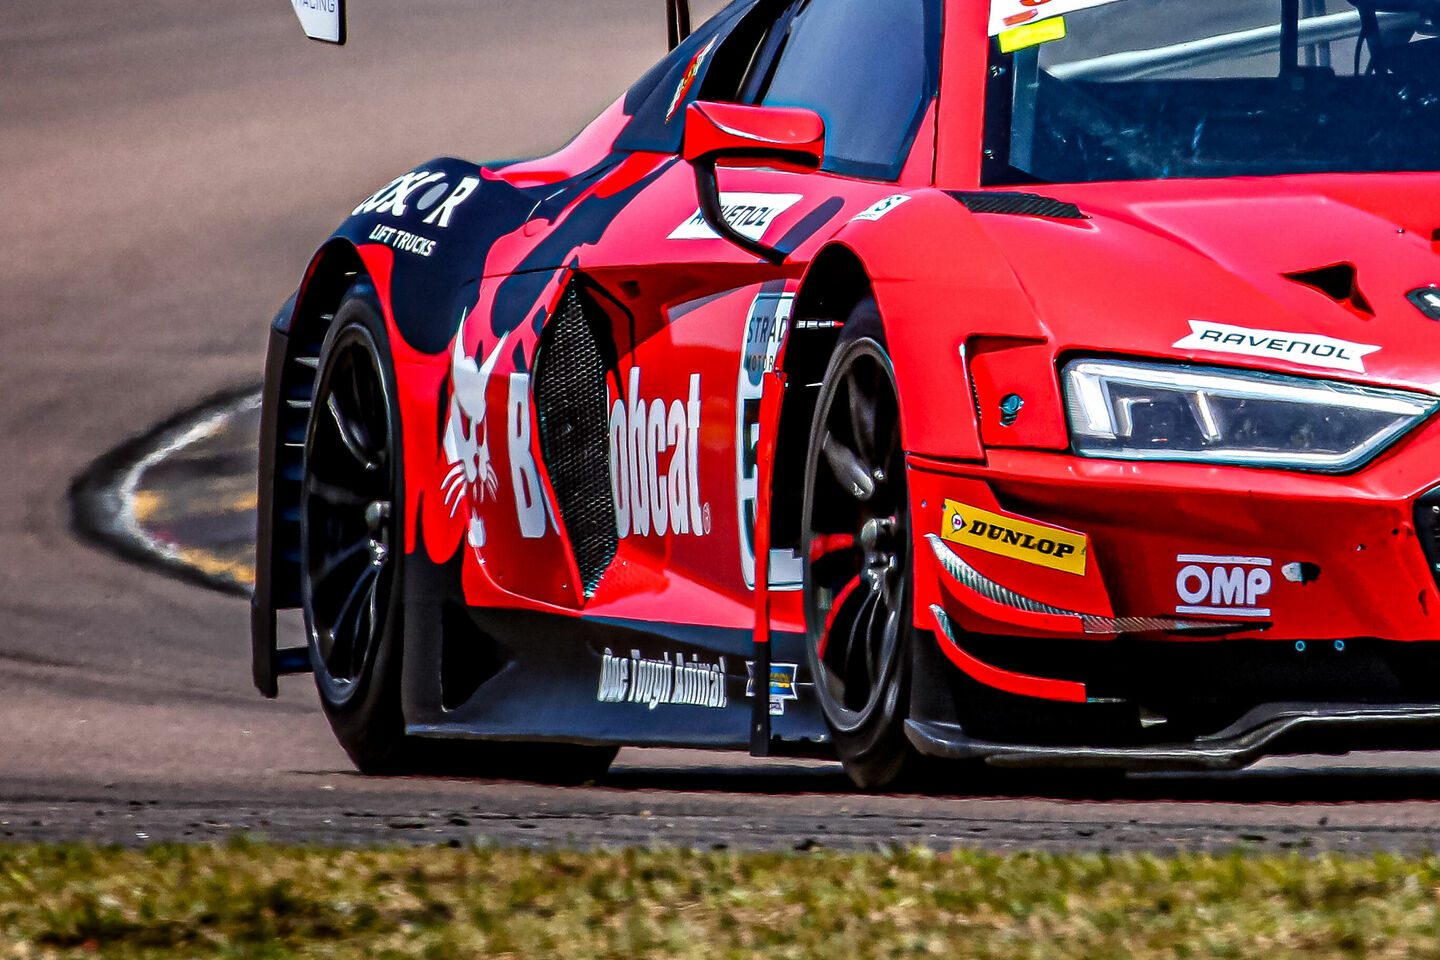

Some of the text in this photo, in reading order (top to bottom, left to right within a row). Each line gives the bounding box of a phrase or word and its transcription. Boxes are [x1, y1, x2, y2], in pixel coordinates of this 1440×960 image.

[368, 223, 437, 257] LIFT TRUCKS
[1199, 328, 1351, 360] RAVENOL
[968, 519, 1075, 559] DUNLOP
[1176, 564, 1272, 606] OMP
[597, 647, 629, 702] One
[628, 648, 673, 711] Tough
